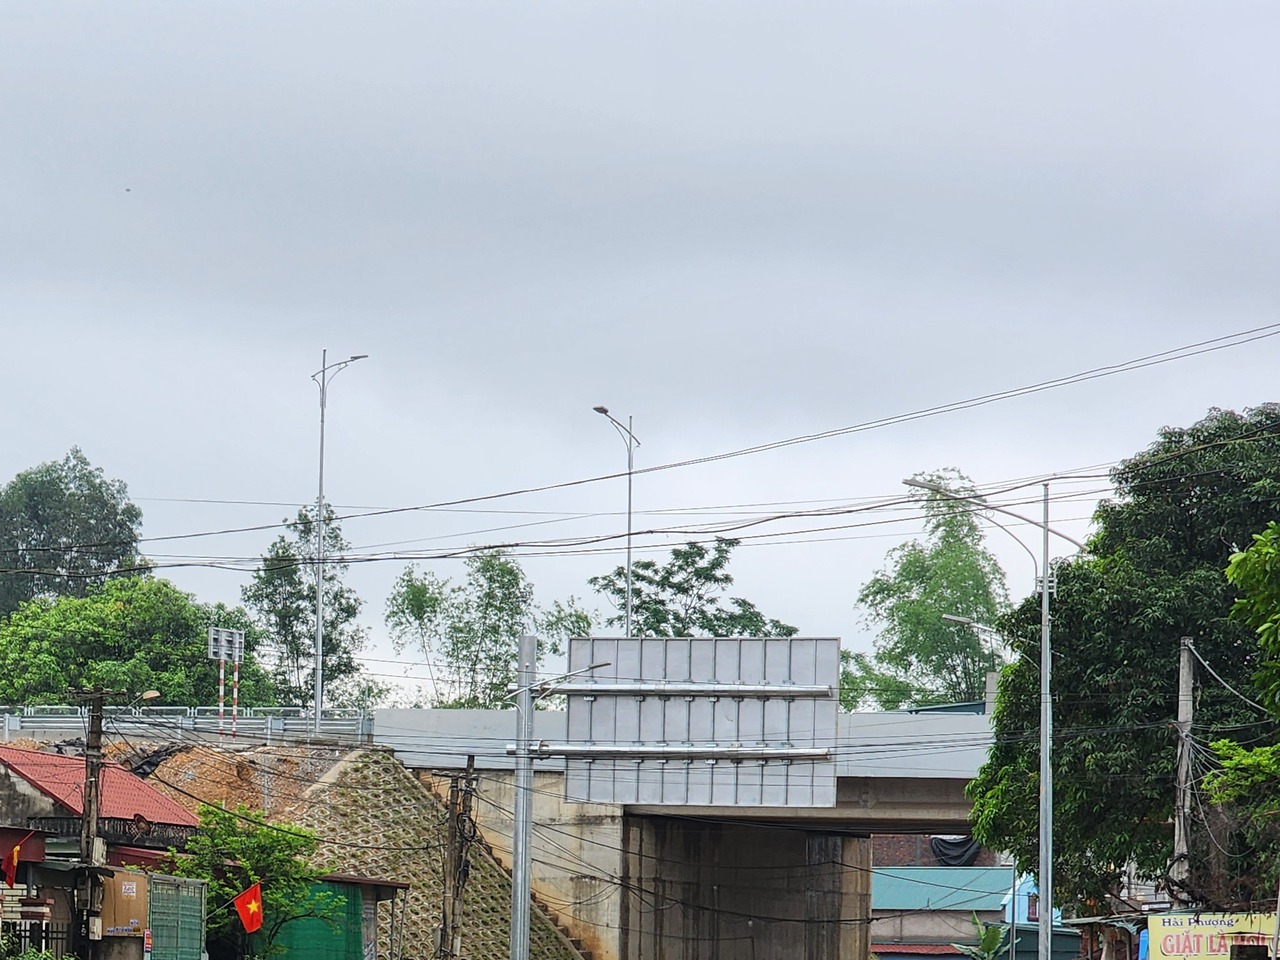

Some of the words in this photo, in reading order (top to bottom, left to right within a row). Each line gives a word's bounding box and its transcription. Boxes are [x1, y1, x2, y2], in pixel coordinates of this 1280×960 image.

[1162, 917, 1183, 927] Hải
[1188, 917, 1235, 928] Phượng
[1161, 930, 1202, 958] GIẶT
[1208, 930, 1229, 954] LÀ
